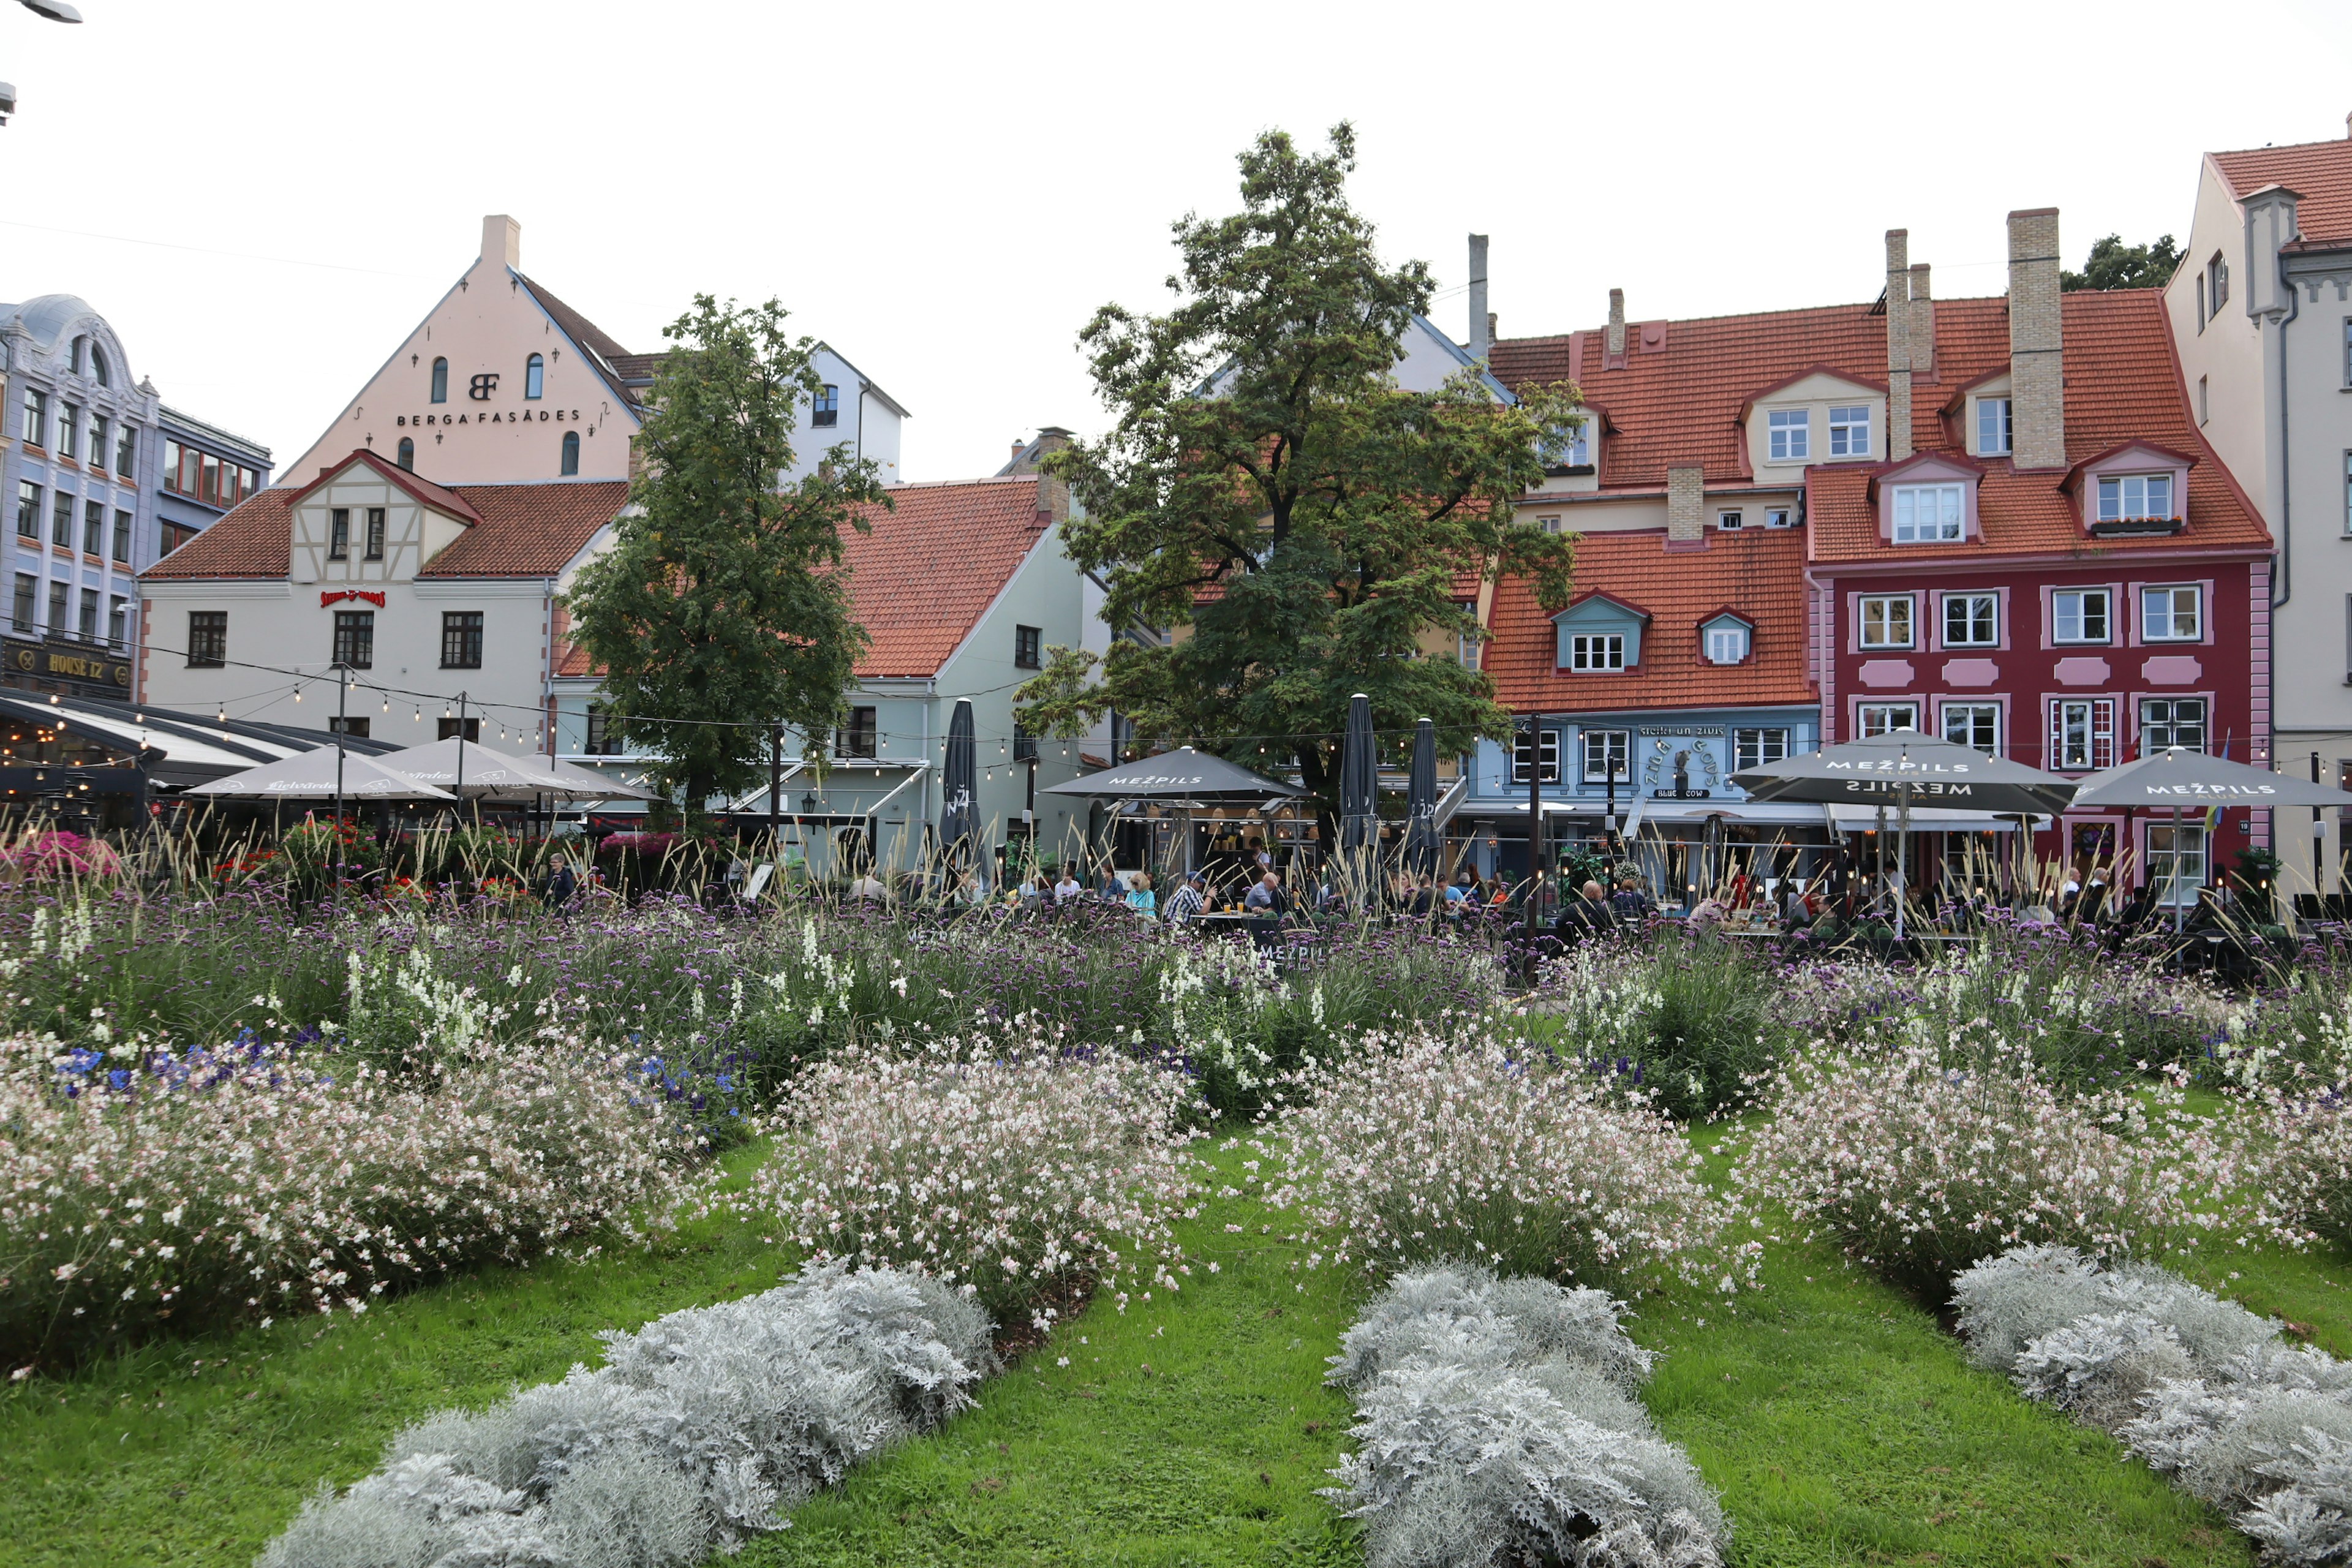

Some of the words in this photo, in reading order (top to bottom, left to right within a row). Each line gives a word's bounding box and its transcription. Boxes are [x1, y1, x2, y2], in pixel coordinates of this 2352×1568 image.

[397, 415, 468, 426] BERGA
[478, 410, 579, 423] FASĀDES
[49, 654, 86, 676] HOUSE
[89, 662, 102, 679] 12
[1826, 760, 1970, 772] MEŽPILS
[1108, 775, 1203, 785] MEŽPILS
[2146, 783, 2276, 794] MEŽPILS
